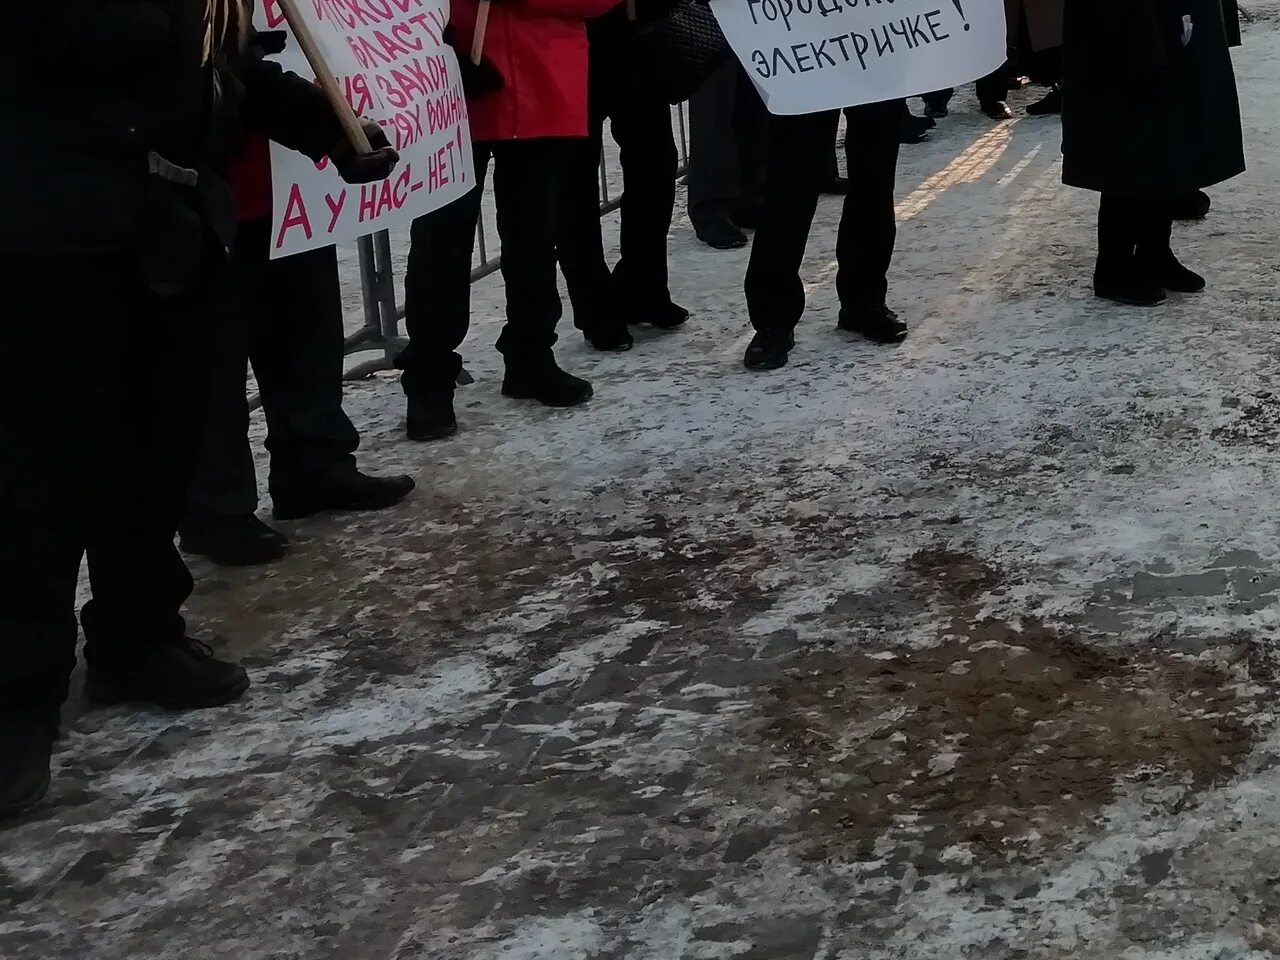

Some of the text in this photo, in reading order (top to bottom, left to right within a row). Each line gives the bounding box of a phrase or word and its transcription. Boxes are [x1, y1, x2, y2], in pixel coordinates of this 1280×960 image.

[378, 54, 448, 108] ЗАКОН
[276, 182, 313, 249] А
[325, 187, 347, 233] У
